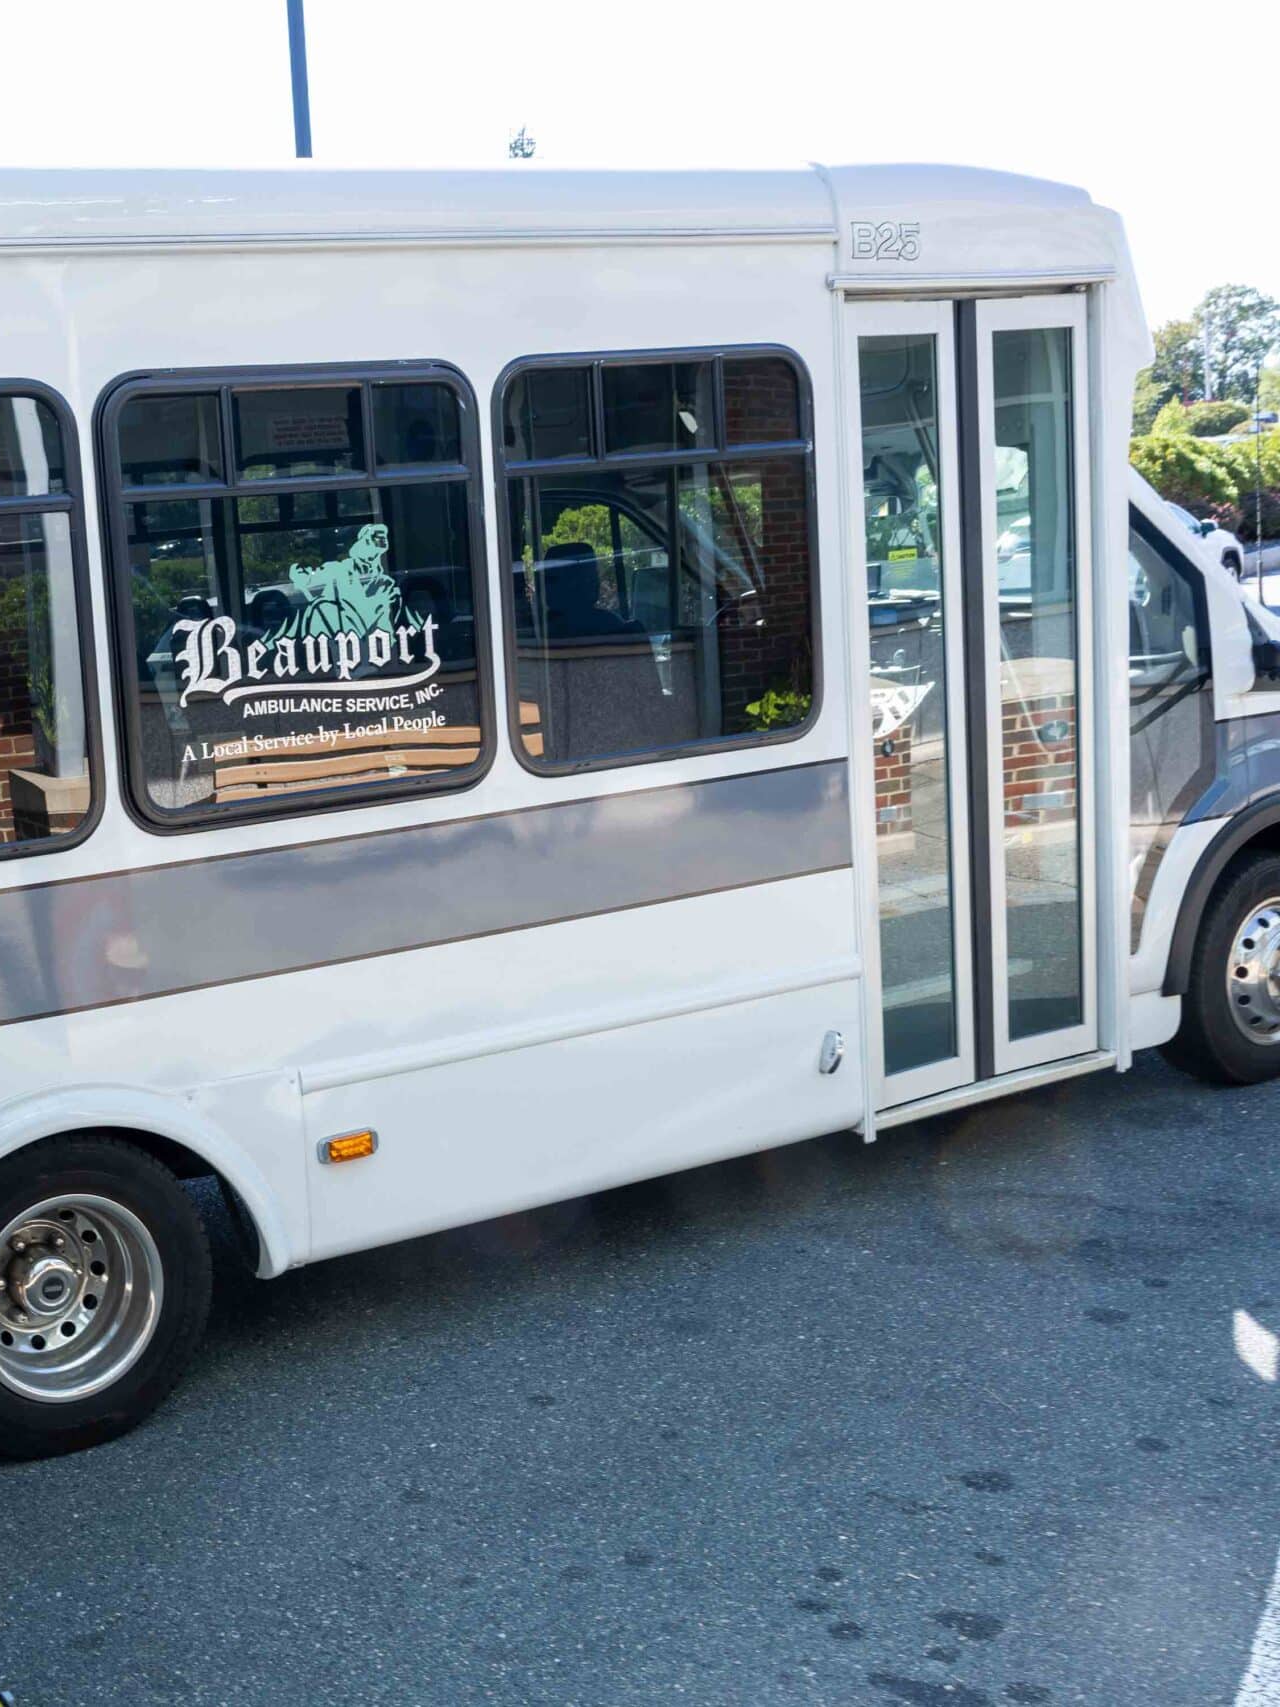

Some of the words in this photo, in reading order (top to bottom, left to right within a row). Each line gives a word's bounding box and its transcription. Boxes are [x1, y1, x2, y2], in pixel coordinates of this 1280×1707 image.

[851, 221, 920, 260] B25
[172, 613, 441, 708] Beauport
[243, 698, 342, 719] AMBULANCE
[346, 694, 414, 713] SERVICE,
[415, 683, 444, 705] INC.
[181, 744, 198, 762] A
[200, 736, 248, 759] Local
[253, 731, 315, 752] Service
[317, 725, 339, 747] by
[343, 716, 388, 739] Local
[392, 710, 446, 734] People
